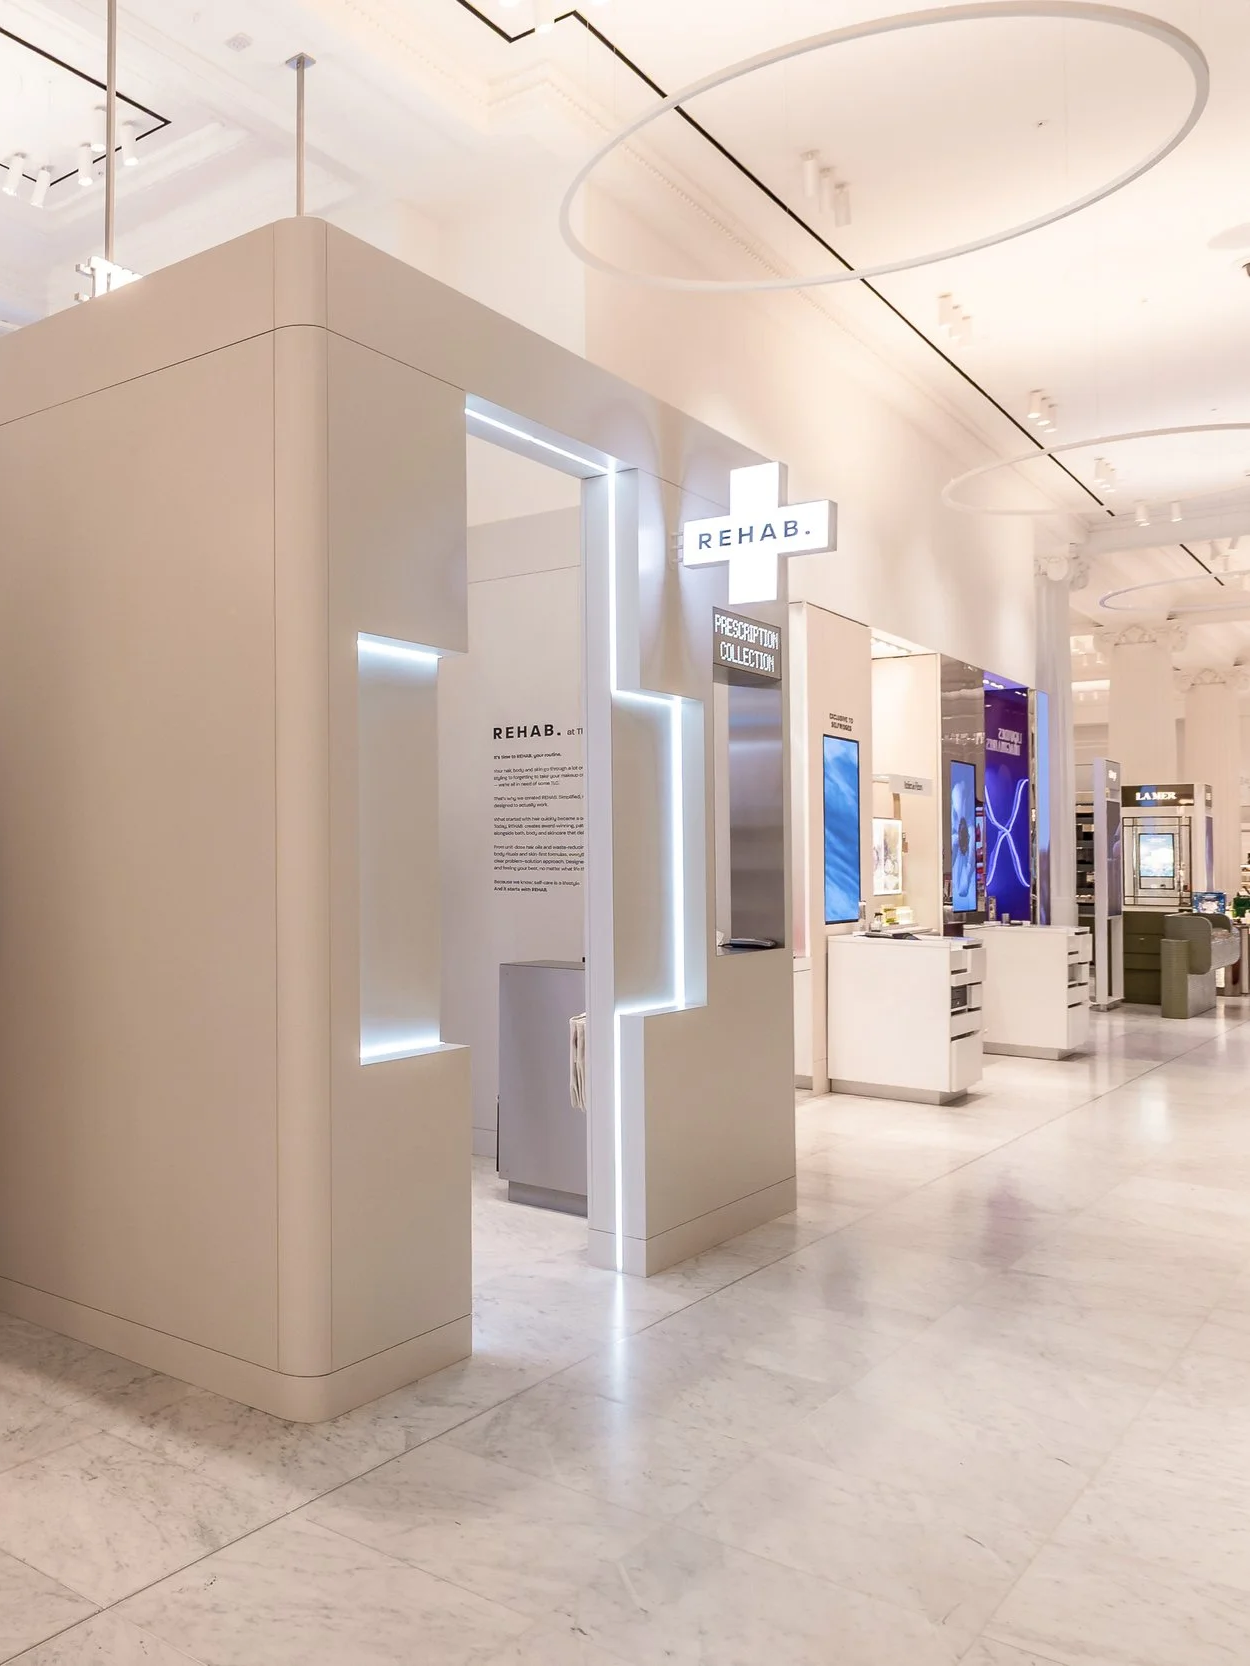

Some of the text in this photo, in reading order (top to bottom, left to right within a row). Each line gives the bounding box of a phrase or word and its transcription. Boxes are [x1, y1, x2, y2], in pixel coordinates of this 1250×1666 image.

[698, 520, 811, 550] REHAB.
[714, 614, 779, 650] PRESCRIPTION
[720, 641, 775, 673] COLLECTION
[493, 724, 562, 740] REHAB.
